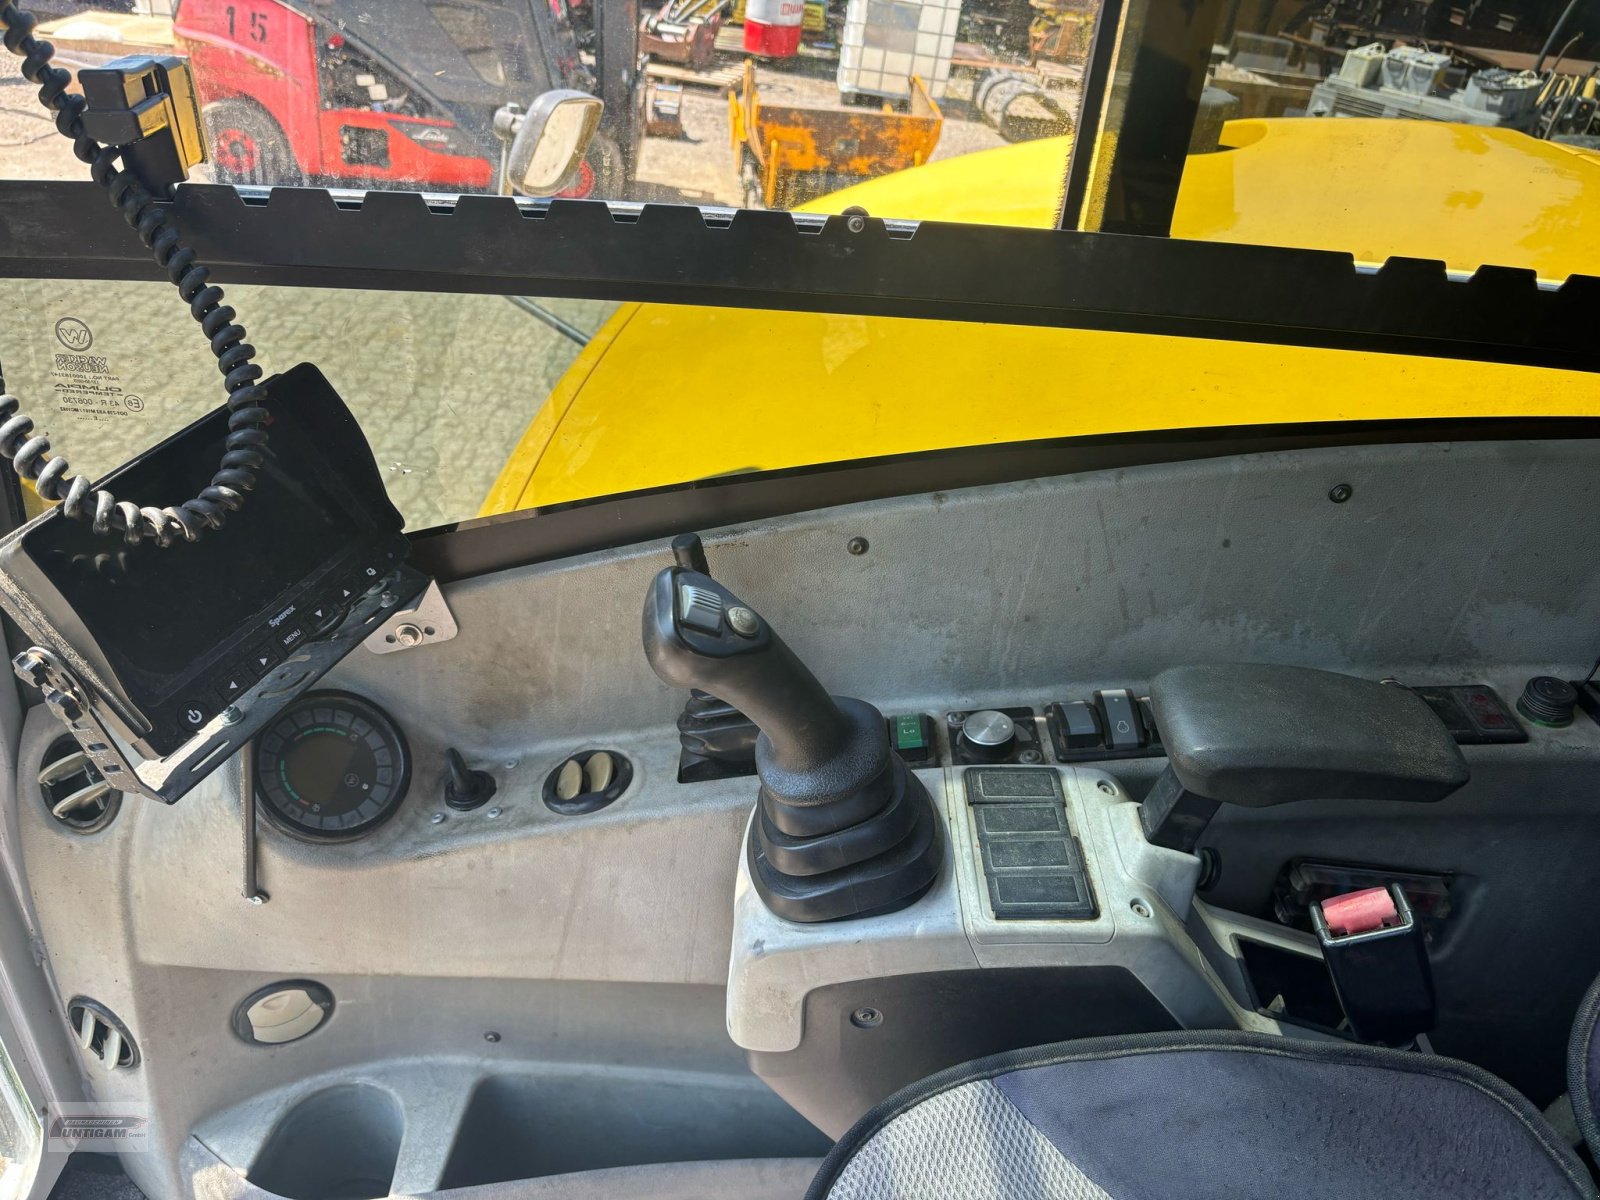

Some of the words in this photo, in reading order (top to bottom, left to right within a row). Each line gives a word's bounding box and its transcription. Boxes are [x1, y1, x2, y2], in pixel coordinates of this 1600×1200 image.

[226, 6, 267, 43] 15
[268, 604, 297, 628] Sparex
[283, 629, 301, 645] MENU
